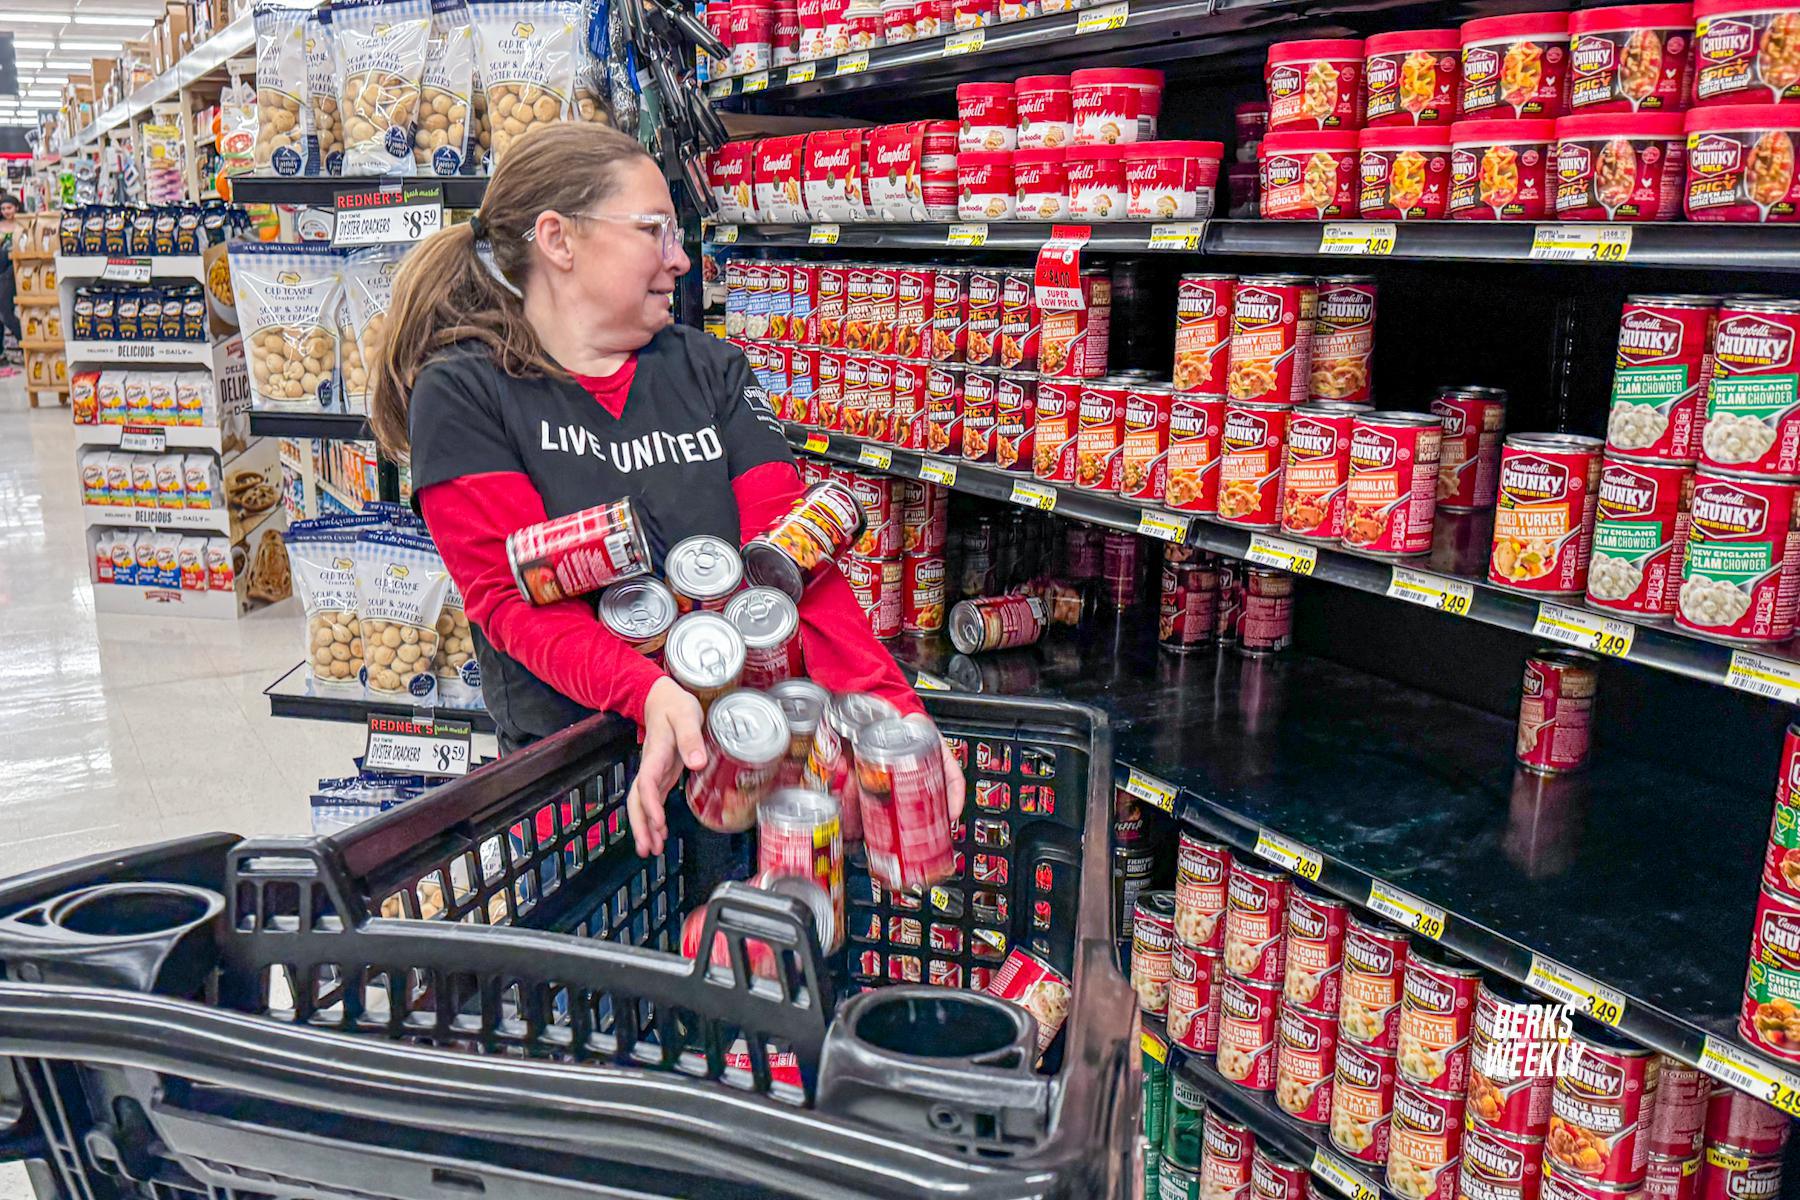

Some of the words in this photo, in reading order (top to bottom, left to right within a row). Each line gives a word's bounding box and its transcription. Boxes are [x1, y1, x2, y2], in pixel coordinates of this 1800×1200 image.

[1703, 35, 1749, 53] CHUNKY
[1573, 51, 1611, 65] CHUNKY
[1367, 68, 1394, 84] CHUNKY
[1464, 61, 1496, 75] CHUNKY
[1700, 63, 1749, 83] SPICY
[1271, 77, 1299, 92] CHUNKY
[1573, 77, 1611, 95] SPICY
[1367, 93, 1396, 108] SPICY
[1464, 85, 1497, 102] SPICY
[1271, 105, 1301, 120] NOODLE
[813, 148, 850, 169] Campbell's
[877, 143, 911, 165] Campbell's
[1692, 150, 1736, 166] CHUNKY
[712, 159, 743, 178] Campbell's
[763, 153, 793, 173] Campbell's
[1558, 158, 1588, 172] CHUNKY
[1269, 167, 1297, 181] CHUNKY
[1557, 181, 1588, 197] SPICY
[1690, 175, 1736, 195] SPICY
[337, 191, 403, 209] REDNER'S
[1269, 195, 1301, 209] NOODLE
[339, 218, 361, 236] OYSTER
[361, 216, 391, 235] CRACKERS
[1363, 239, 1389, 255] 3.49
[1586, 243, 1623, 260] 3.49
[1046, 289, 1069, 298] SUPER
[1328, 293, 1364, 303] Campbell's
[1041, 298, 1057, 307] LOW
[1057, 299, 1079, 308] PRICE
[1317, 301, 1371, 320] CHUNKY
[1234, 303, 1278, 321] CHUNKY
[1624, 315, 1663, 331] Campbell's
[1726, 321, 1771, 337] Campbell's
[1618, 329, 1675, 353] CHUNKY
[1716, 332, 1788, 361] CHUNKY
[118, 345, 155, 358] DELICIOUS
[166, 348, 187, 356] DAILY
[1617, 374, 1634, 383] NEW
[1634, 374, 1683, 382] ENGLAND
[1617, 381, 1641, 396] CLAM
[1641, 381, 1683, 394] CHOWDER
[1716, 384, 1735, 392] NEW
[1737, 383, 1793, 392] ENGLAND
[1715, 392, 1746, 405] CLAM
[1747, 391, 1793, 405] CHOWDER
[540, 419, 607, 462] LIVE
[609, 427, 724, 474] UNITED
[1511, 460, 1550, 475] Campbell's
[1502, 467, 1564, 495] CHUNKY
[1604, 471, 1638, 487] Campbell's
[1702, 487, 1747, 506] Campbell's
[135, 510, 172, 524] DELICIOUS
[183, 515, 204, 523] DAILY
[1518, 512, 1567, 527] TURKEY
[1692, 497, 1762, 529] CHUNKY
[1527, 527, 1547, 536] WILD
[1548, 527, 1566, 536] RICE
[1610, 529, 1656, 537] ENGLAND
[1595, 535, 1618, 548] CLAM
[1618, 536, 1657, 549] CHOWDER
[1692, 549, 1712, 557] NEW
[1713, 551, 1767, 559] ENGLAND
[1285, 556, 1312, 576] 3.49
[1692, 556, 1722, 570] CLAM
[1723, 558, 1767, 571] CHOWDER
[1436, 592, 1466, 614] 3.49
[1589, 631, 1625, 656] 3.49
[371, 718, 434, 736] REDNER'S
[371, 743, 393, 760] OYSTER
[393, 744, 421, 763] CRACKERS
[1178, 856, 1219, 880] CHUNKY
[1291, 856, 1318, 880] 3.49
[1198, 891, 1222, 903] CORN
[1243, 918, 1267, 932] CORN
[1411, 912, 1441, 938] 3.49
[1763, 920, 1800, 953] CHU
[1301, 948, 1326, 961] CORN
[1360, 990, 1377, 1002] POT
[1377, 992, 1393, 1004] PIE
[1404, 971, 1452, 1009] CHUNKY
[1582, 995, 1618, 1024] 3.49
[1234, 1026, 1261, 1040] CORN
[1419, 1028, 1437, 1041] POT
[1438, 1031, 1453, 1043] PIE
[1293, 1057, 1321, 1072] CORN
[1349, 1099, 1365, 1113] POT
[1365, 1103, 1380, 1117] PIE
[1394, 1091, 1441, 1130] CHUNKY
[1552, 1096, 1623, 1128] BURGER
[1592, 1104, 1621, 1116] BBQ
[1410, 1146, 1427, 1159] POT
[1428, 1150, 1443, 1162] PIE
[1465, 1135, 1520, 1177] CHUNKY
[1711, 1153, 1742, 1168] NEW!
